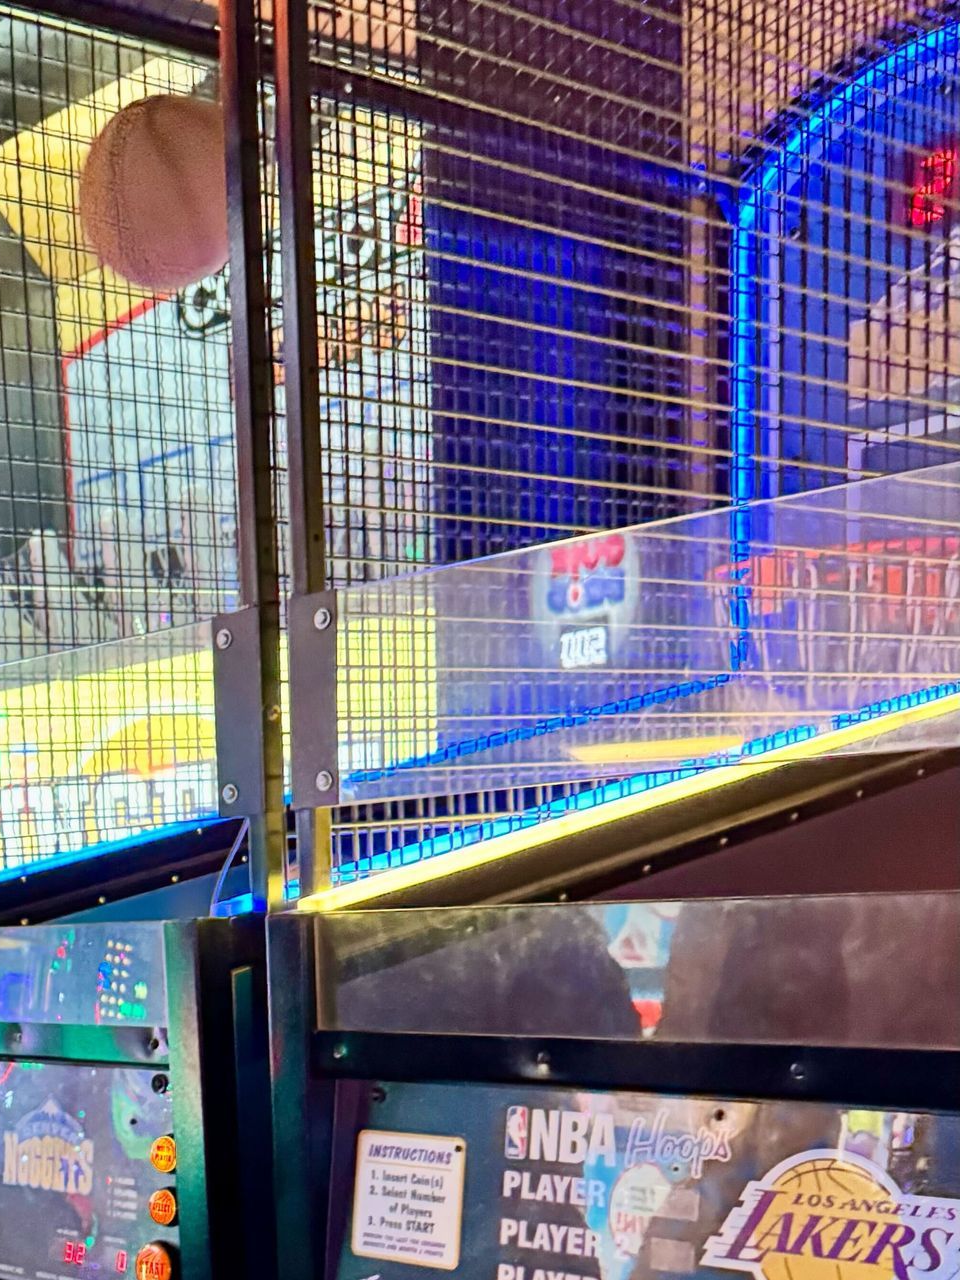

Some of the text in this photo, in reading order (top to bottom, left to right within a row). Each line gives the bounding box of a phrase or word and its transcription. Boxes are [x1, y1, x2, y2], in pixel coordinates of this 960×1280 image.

[368, 1143, 453, 1165] INSTRUCTIONS
[529, 1107, 732, 1180] NBA Hoops
[3, 1130, 95, 1196] NUGGETS
[382, 1170, 408, 1184] Insert
[411, 1173, 444, 1190] Coin(s)
[502, 1170, 607, 1208] PLAYER
[381, 1185, 407, 1199] Select
[410, 1189, 447, 1205] Number
[792, 1193, 957, 1221] LOS ANGELES
[388, 1202, 433, 1219] of Players
[380, 1217, 402, 1230] Press
[406, 1220, 436, 1234] START
[499, 1218, 604, 1259] PLAYER
[64, 1241, 86, 1266] 32
